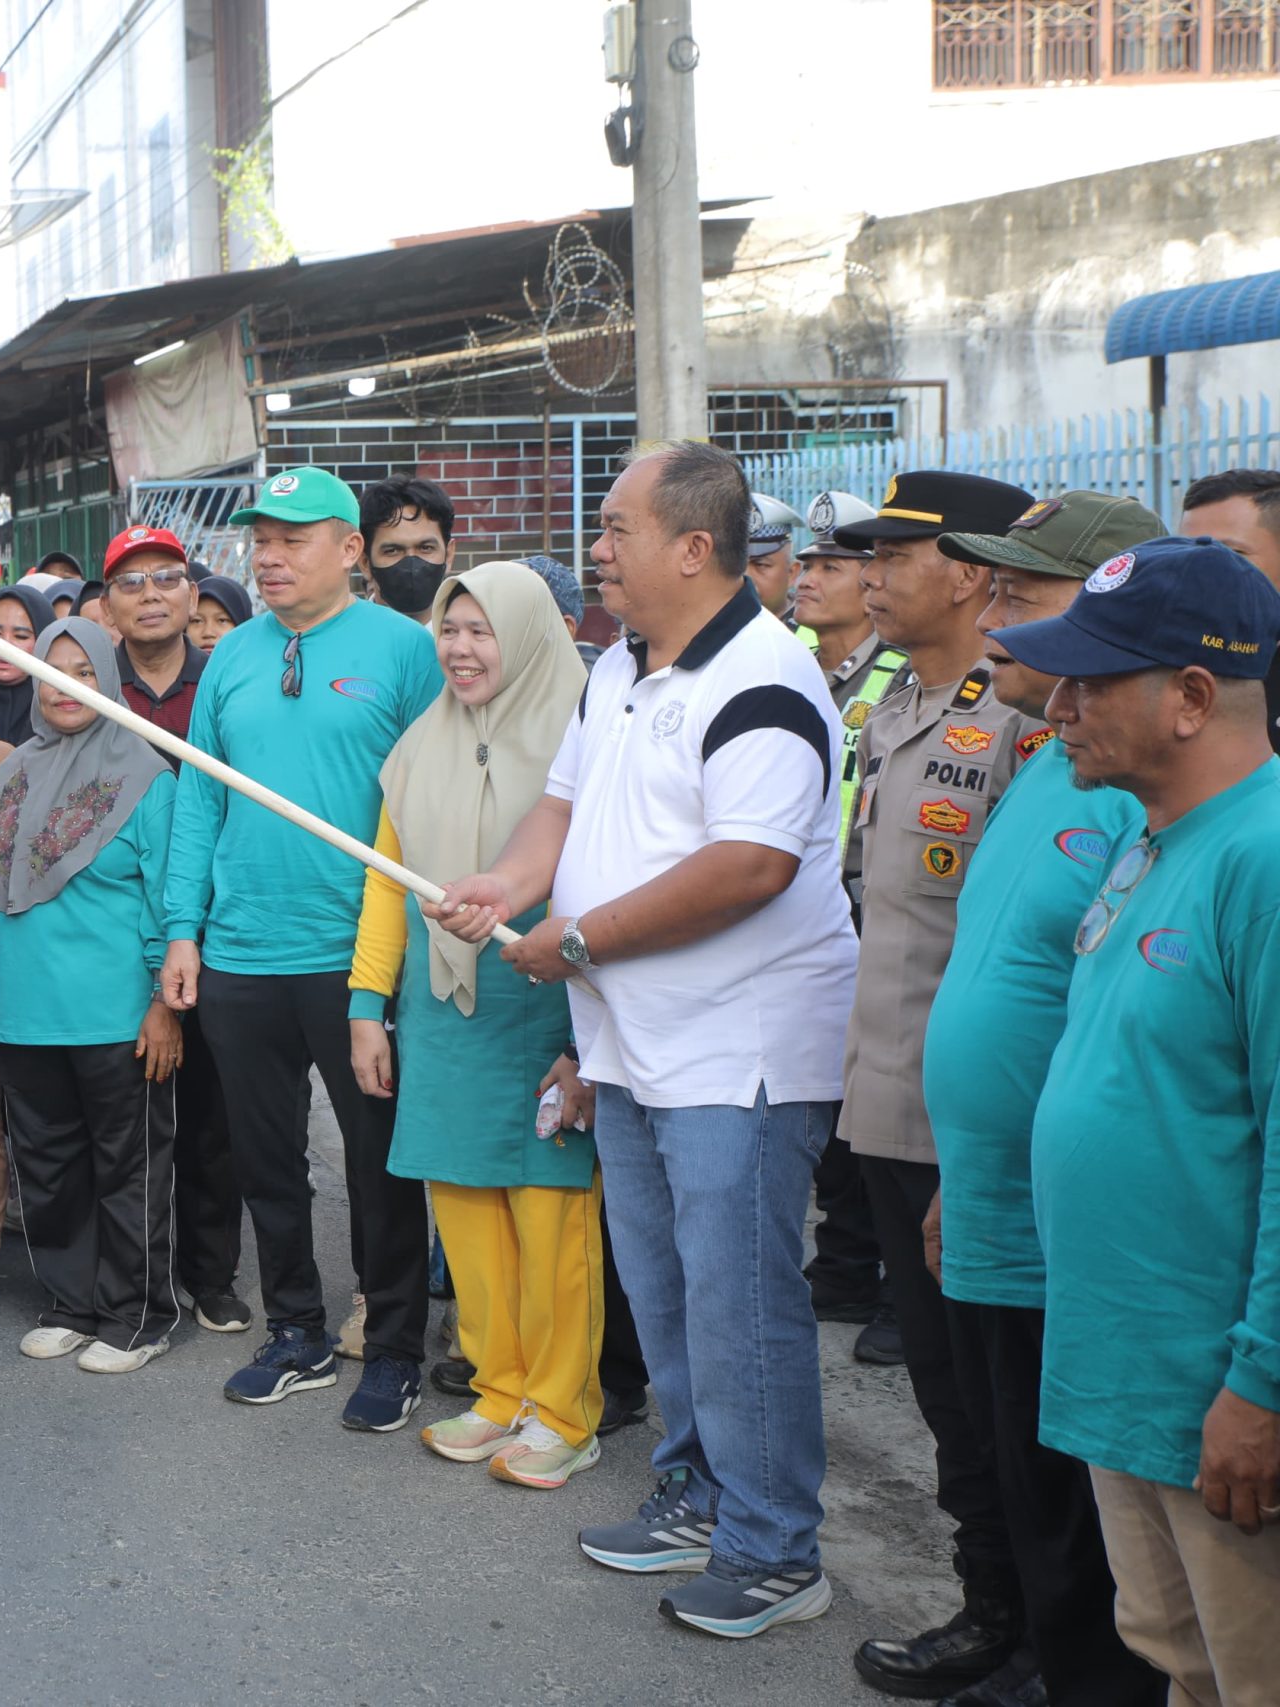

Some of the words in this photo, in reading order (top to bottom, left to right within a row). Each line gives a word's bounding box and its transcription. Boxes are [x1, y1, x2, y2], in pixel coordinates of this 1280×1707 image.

[923, 760, 986, 792] POLRI
[1075, 835, 1109, 859] KSBSI
[1152, 936, 1189, 961] KSBSI
